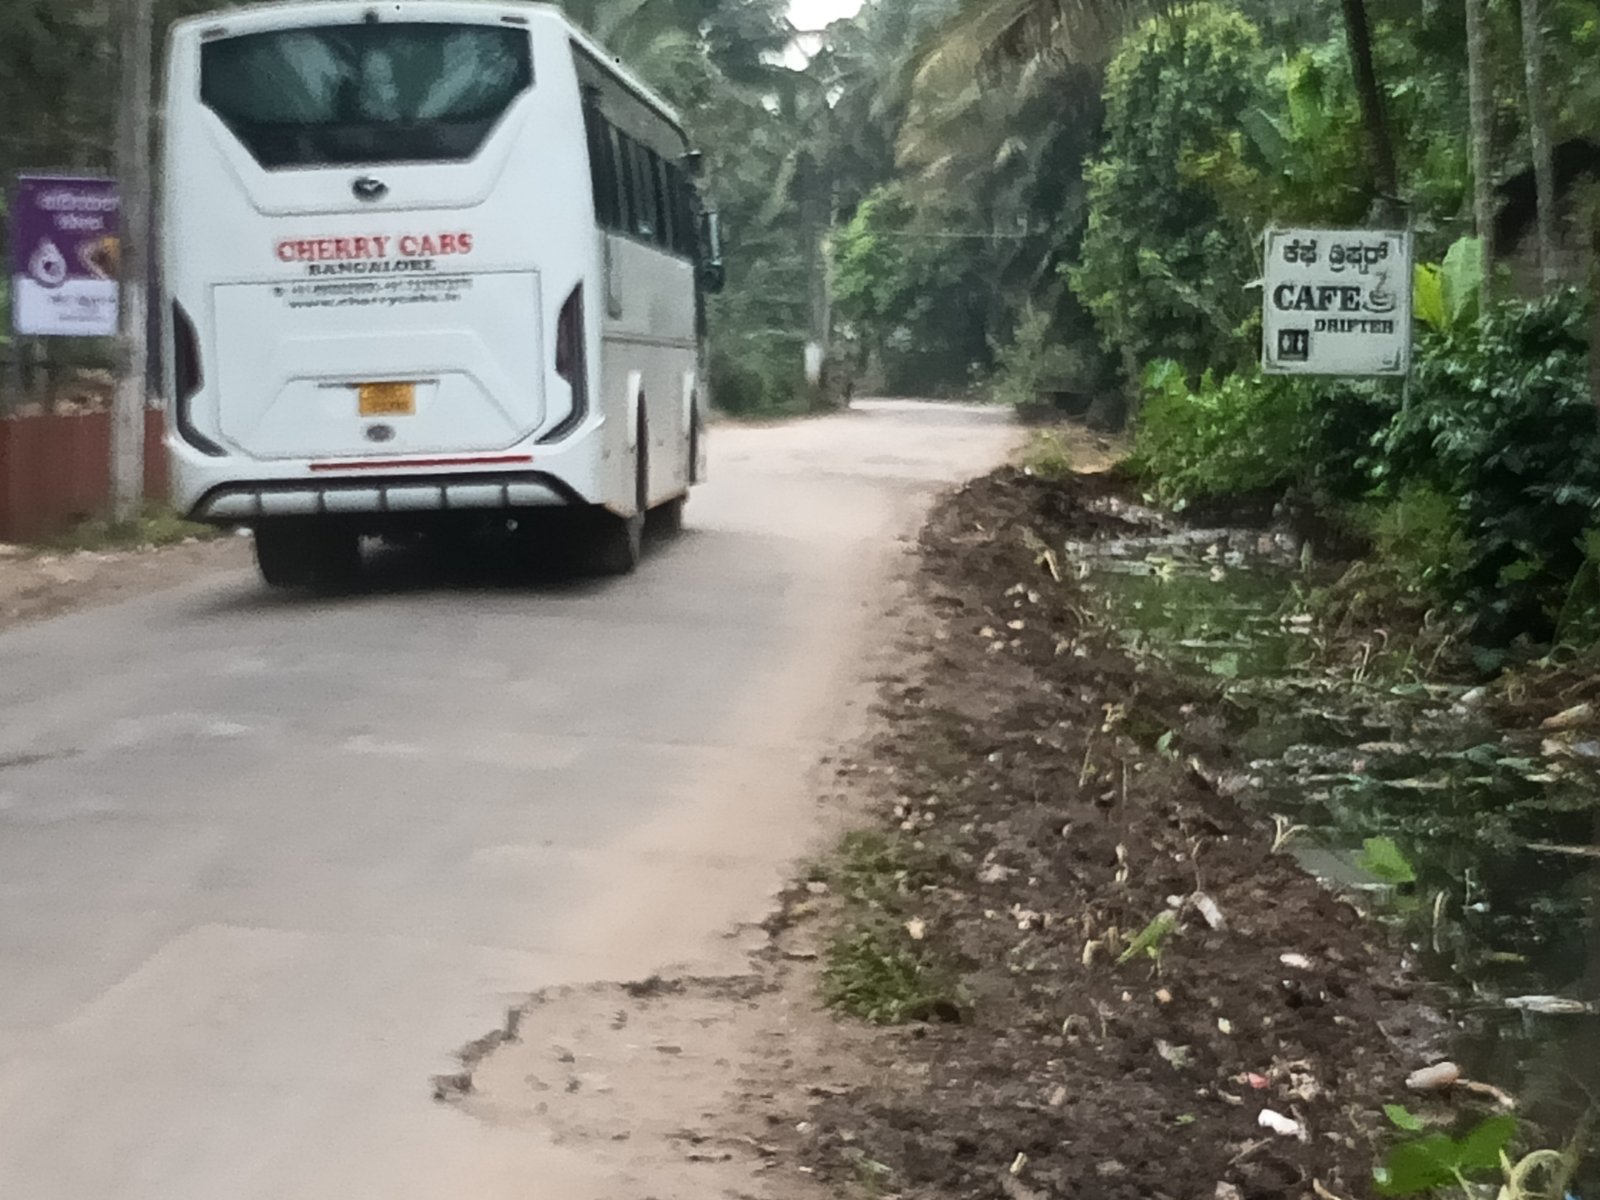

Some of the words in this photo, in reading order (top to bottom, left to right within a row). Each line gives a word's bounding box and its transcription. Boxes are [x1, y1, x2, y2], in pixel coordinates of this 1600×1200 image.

[277, 236, 390, 262] CHERRY
[398, 233, 473, 257] CABS
[308, 259, 436, 276] BANGALORE
[1273, 284, 1360, 311] CAFE
[1314, 319, 1393, 334] DRIFTER
